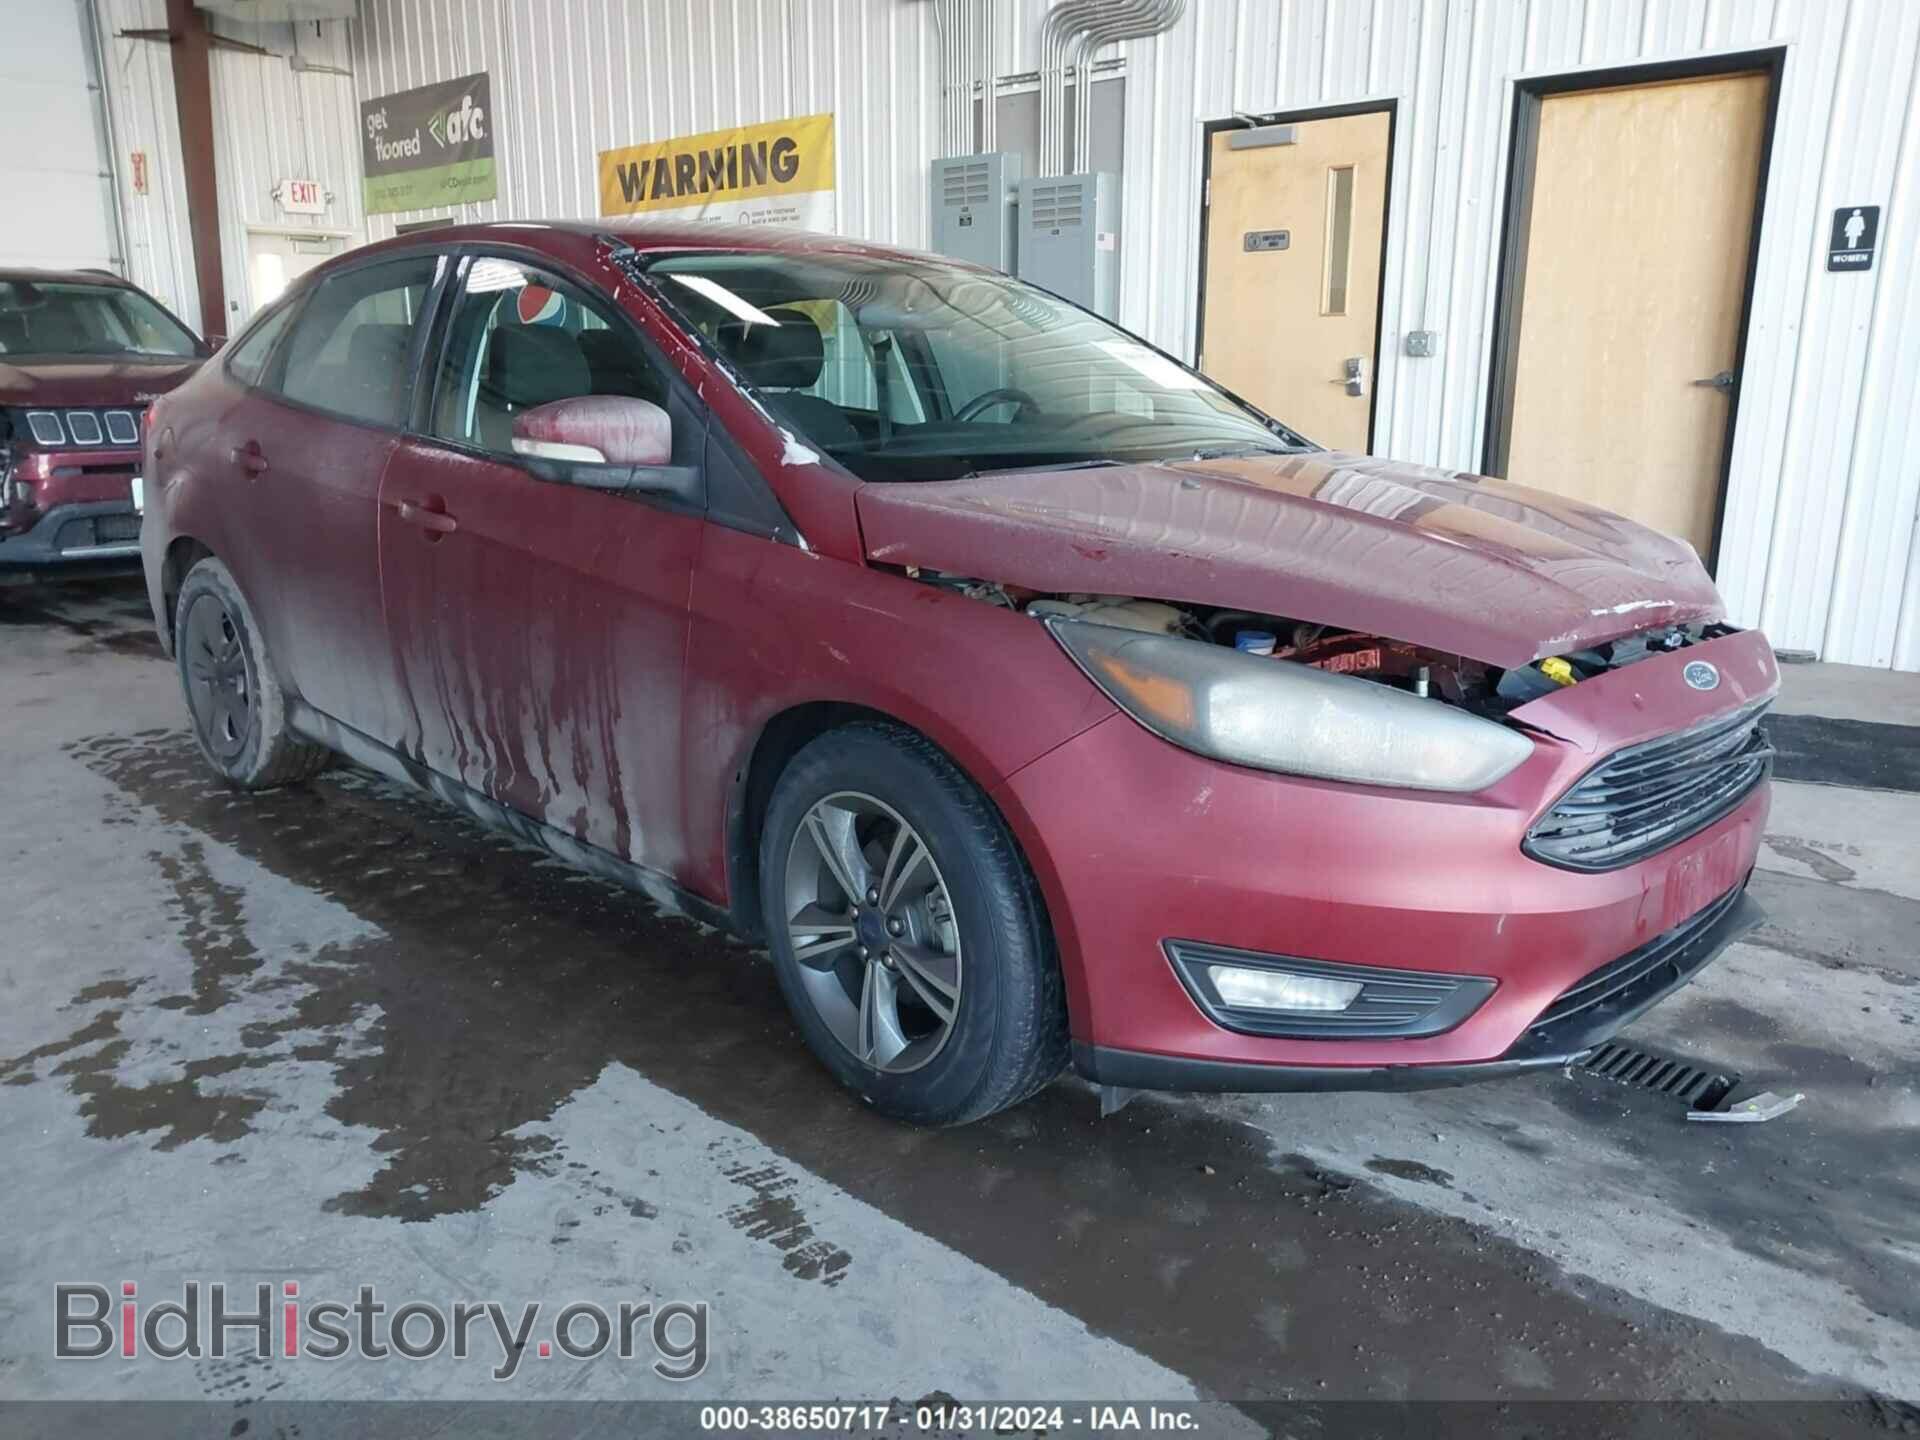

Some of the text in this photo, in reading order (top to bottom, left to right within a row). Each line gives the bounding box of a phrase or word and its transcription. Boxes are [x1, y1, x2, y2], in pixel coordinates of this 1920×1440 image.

[366, 107, 388, 138] get
[375, 127, 421, 162] floored
[616, 136, 800, 203] WARNING
[291, 182, 318, 203] EXIT
[1832, 254, 1868, 263] WOMEN
